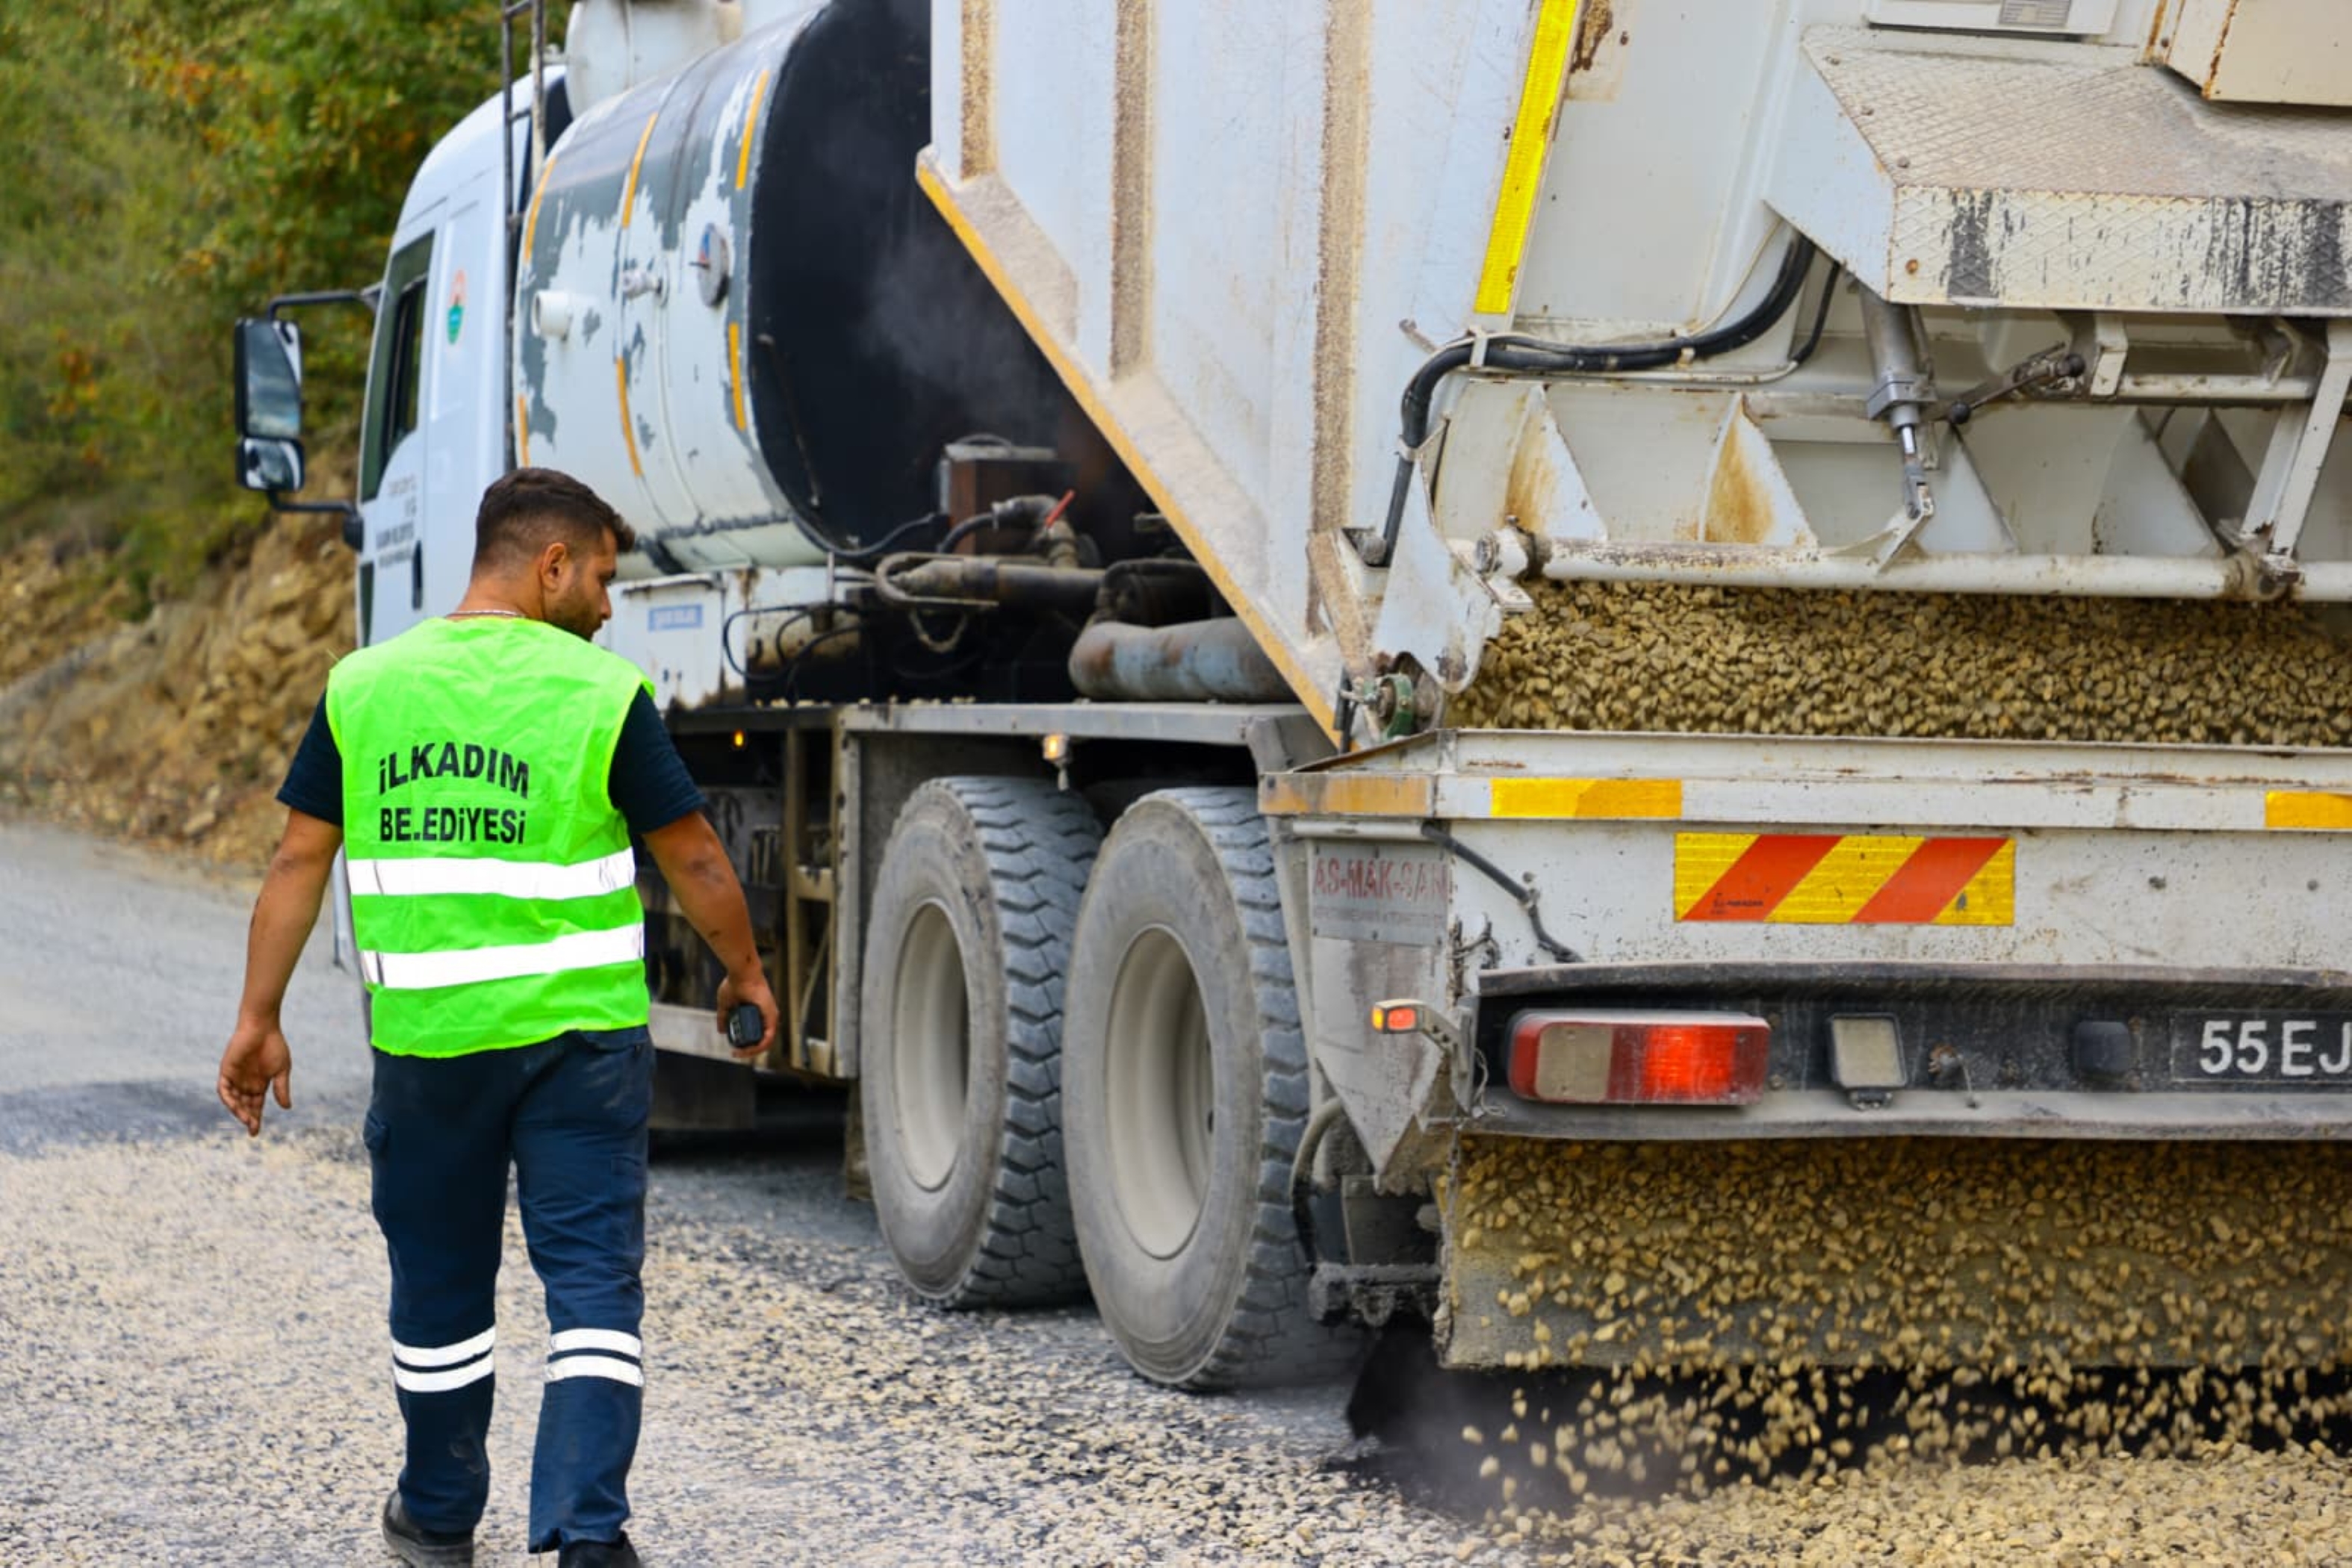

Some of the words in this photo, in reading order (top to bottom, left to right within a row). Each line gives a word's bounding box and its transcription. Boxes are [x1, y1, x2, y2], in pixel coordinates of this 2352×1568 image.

[379, 741, 529, 799] İLKADIM
[379, 807, 527, 844] BEEDİYESİ
[2200, 1020, 2269, 1074] 55
[2280, 1020, 2352, 1076] EJ
